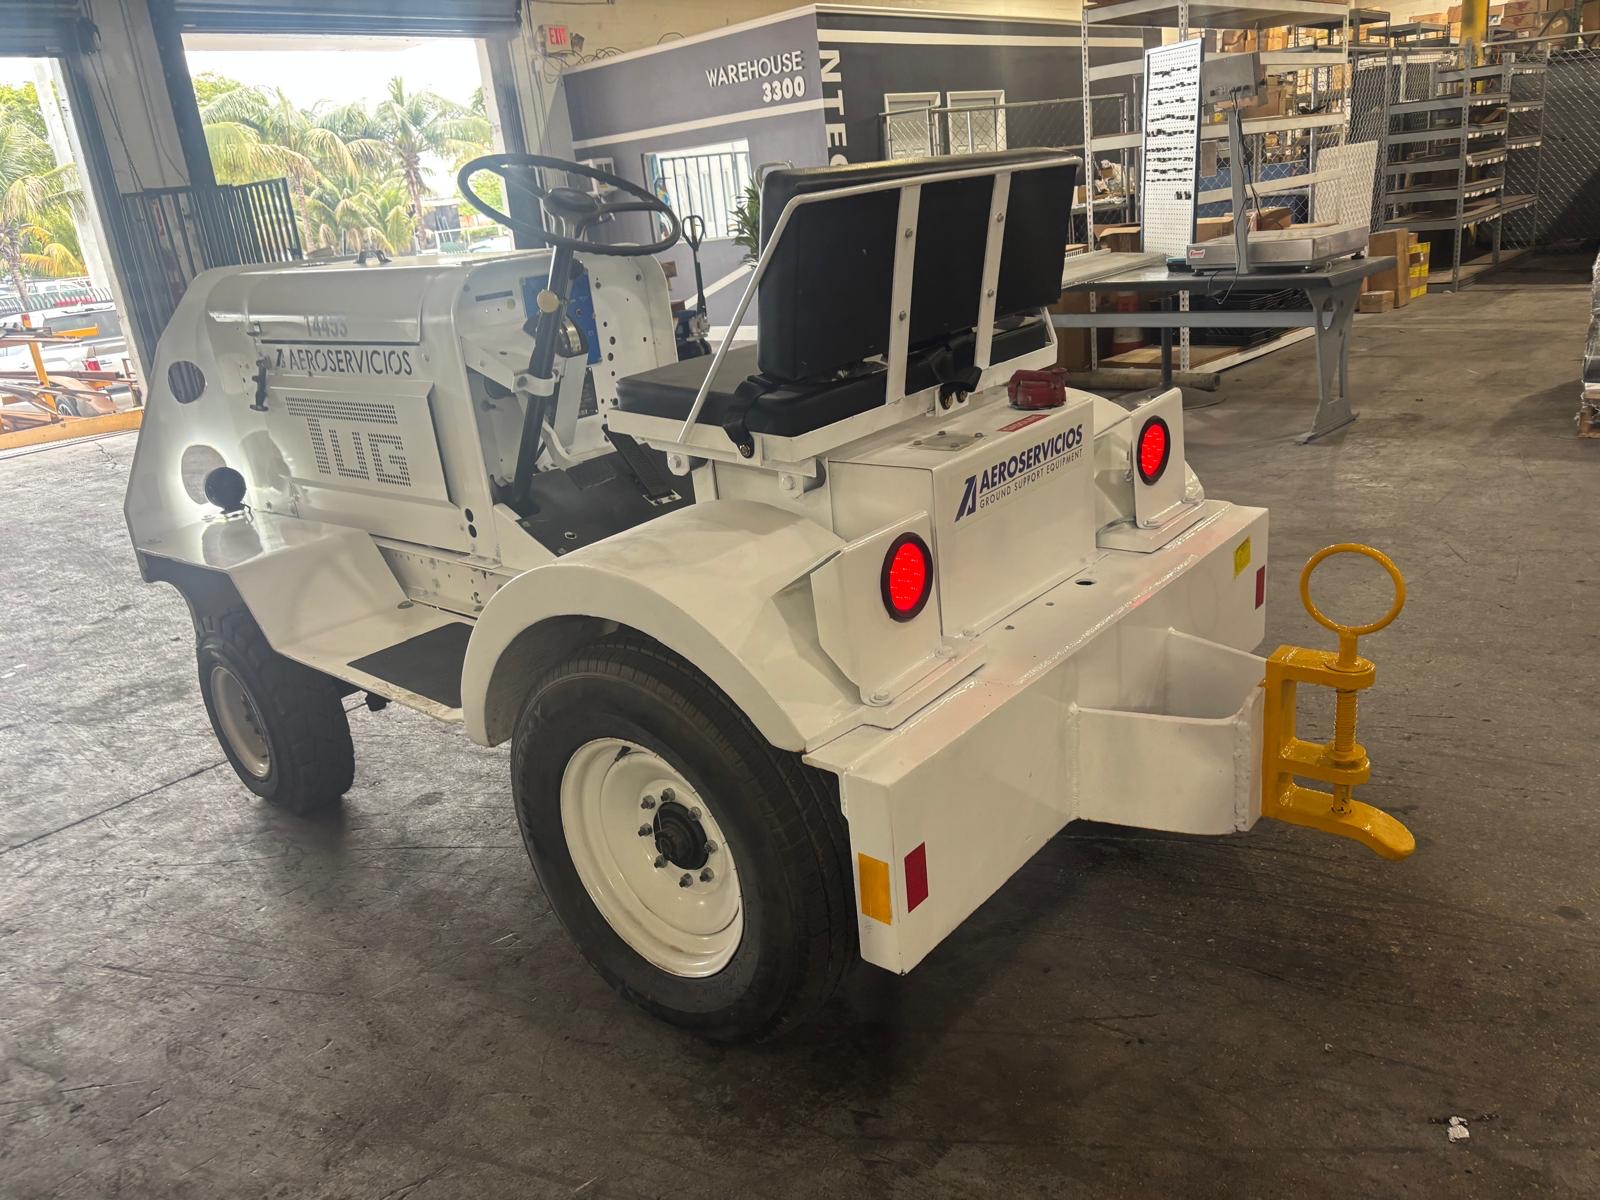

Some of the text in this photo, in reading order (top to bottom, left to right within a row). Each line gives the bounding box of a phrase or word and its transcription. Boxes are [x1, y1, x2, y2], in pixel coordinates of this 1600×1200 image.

[548, 26, 567, 46] EXIT
[705, 50, 803, 88] WAREHOUSE
[762, 76, 805, 103] 3300
[819, 49, 849, 167] NTE
[289, 349, 413, 375] AEROSERVICIOS
[979, 424, 1083, 494] AEROSERVICIOS
[979, 449, 1083, 508] GROUND SUPPORT EQUIPMENT
